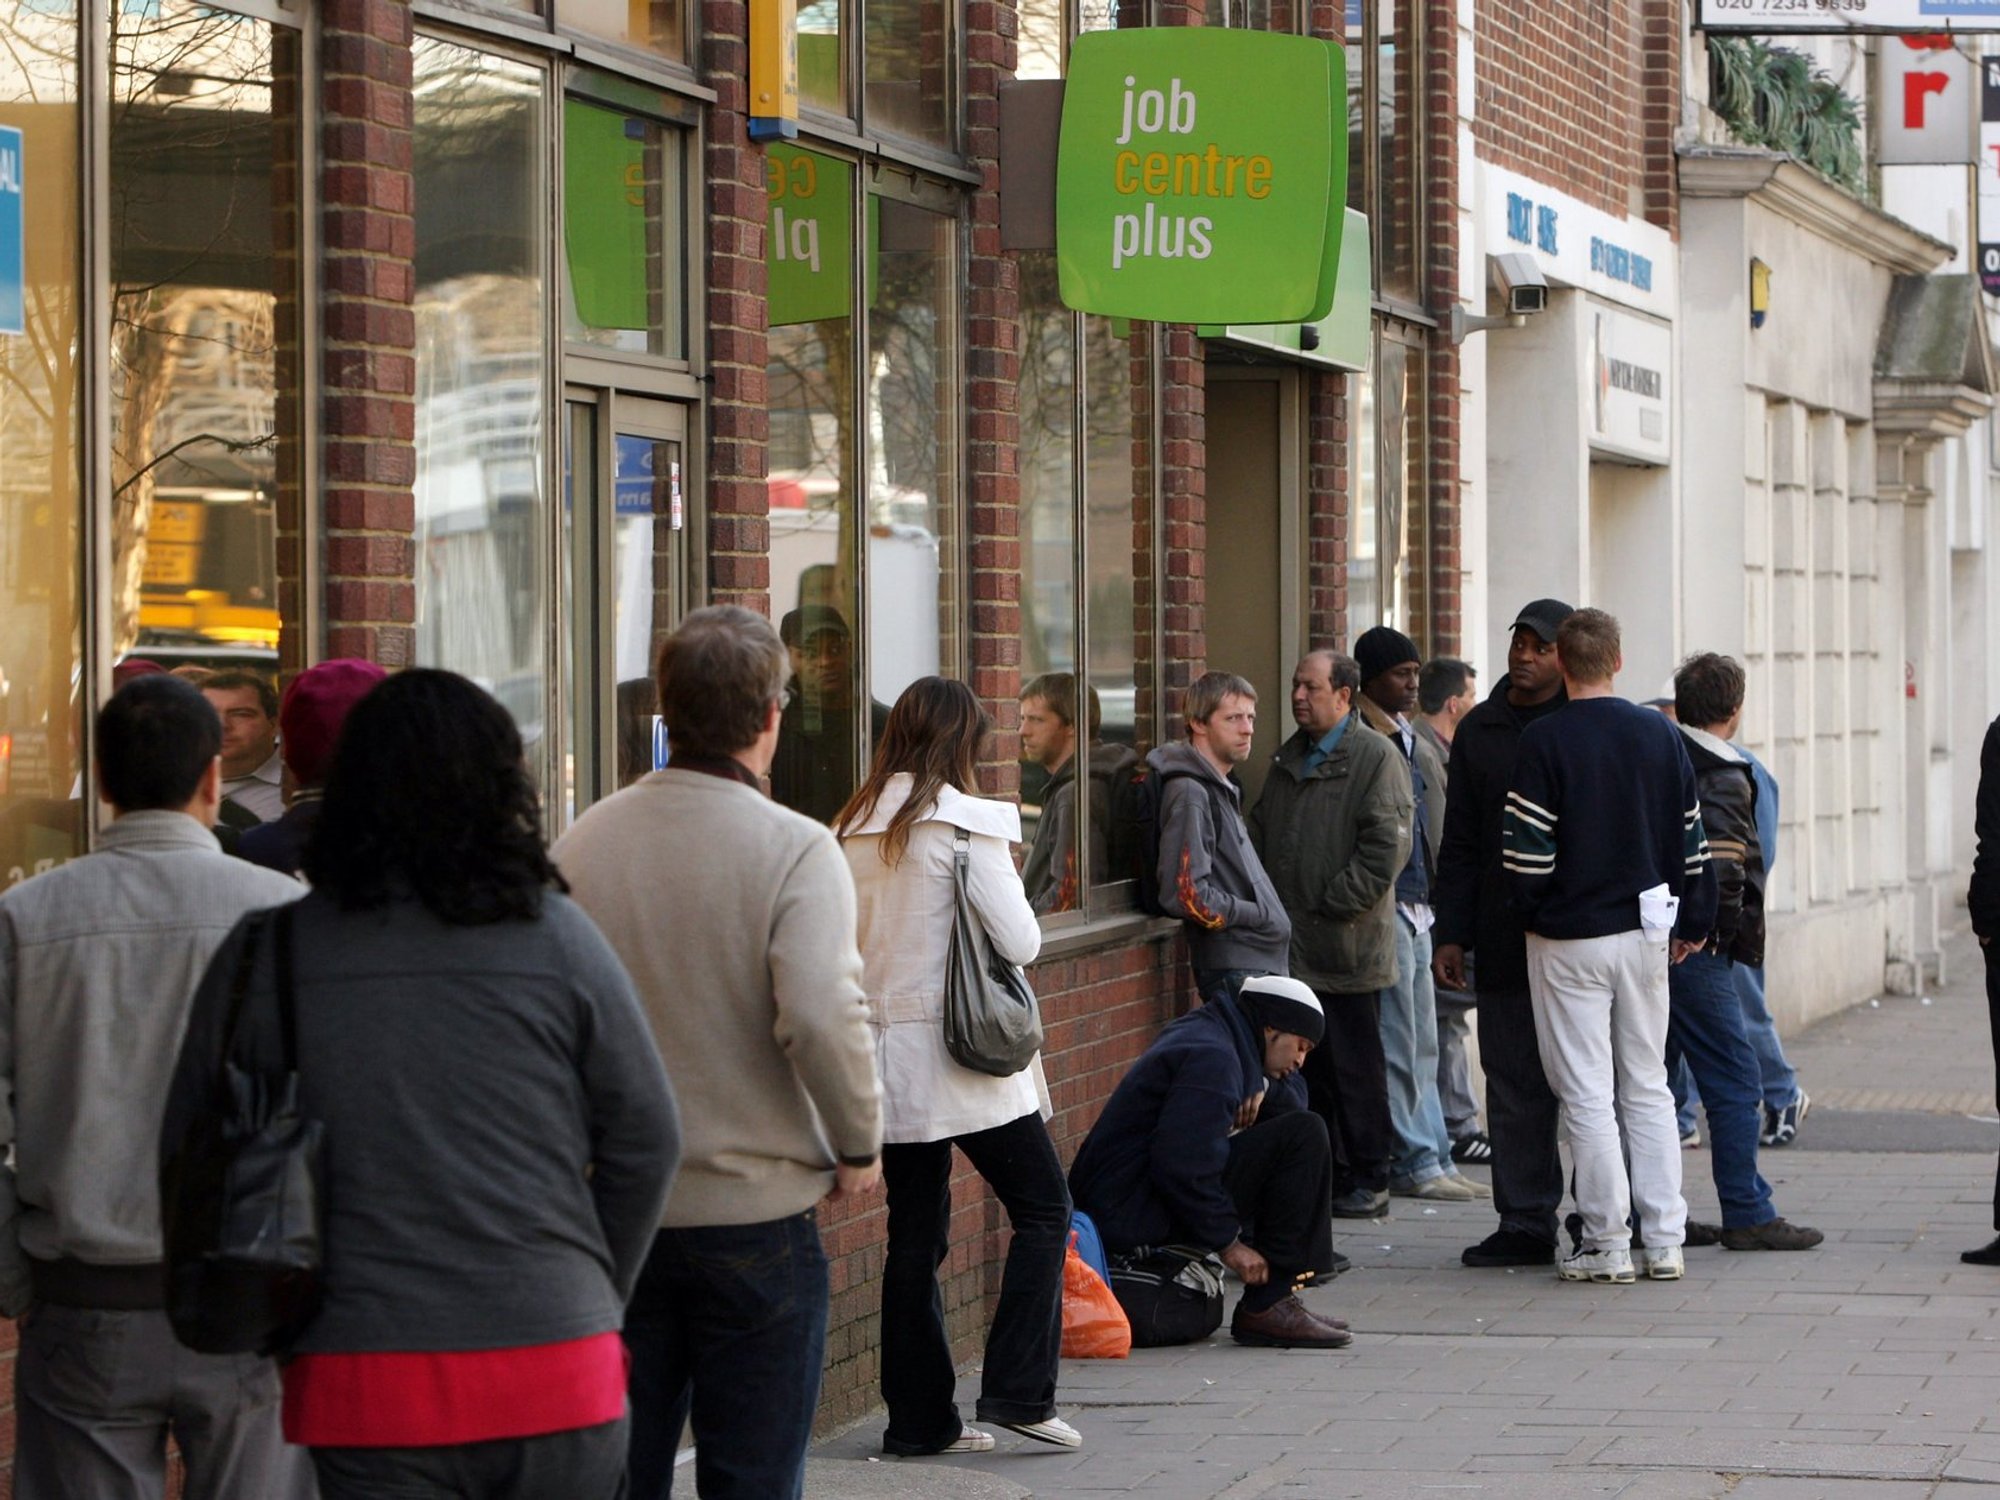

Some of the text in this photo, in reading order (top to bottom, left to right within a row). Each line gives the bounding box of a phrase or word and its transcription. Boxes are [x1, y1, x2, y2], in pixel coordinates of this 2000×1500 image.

[1116, 75, 1197, 145] job
[1114, 143, 1273, 200] centre
[1112, 202, 1214, 270] plus
